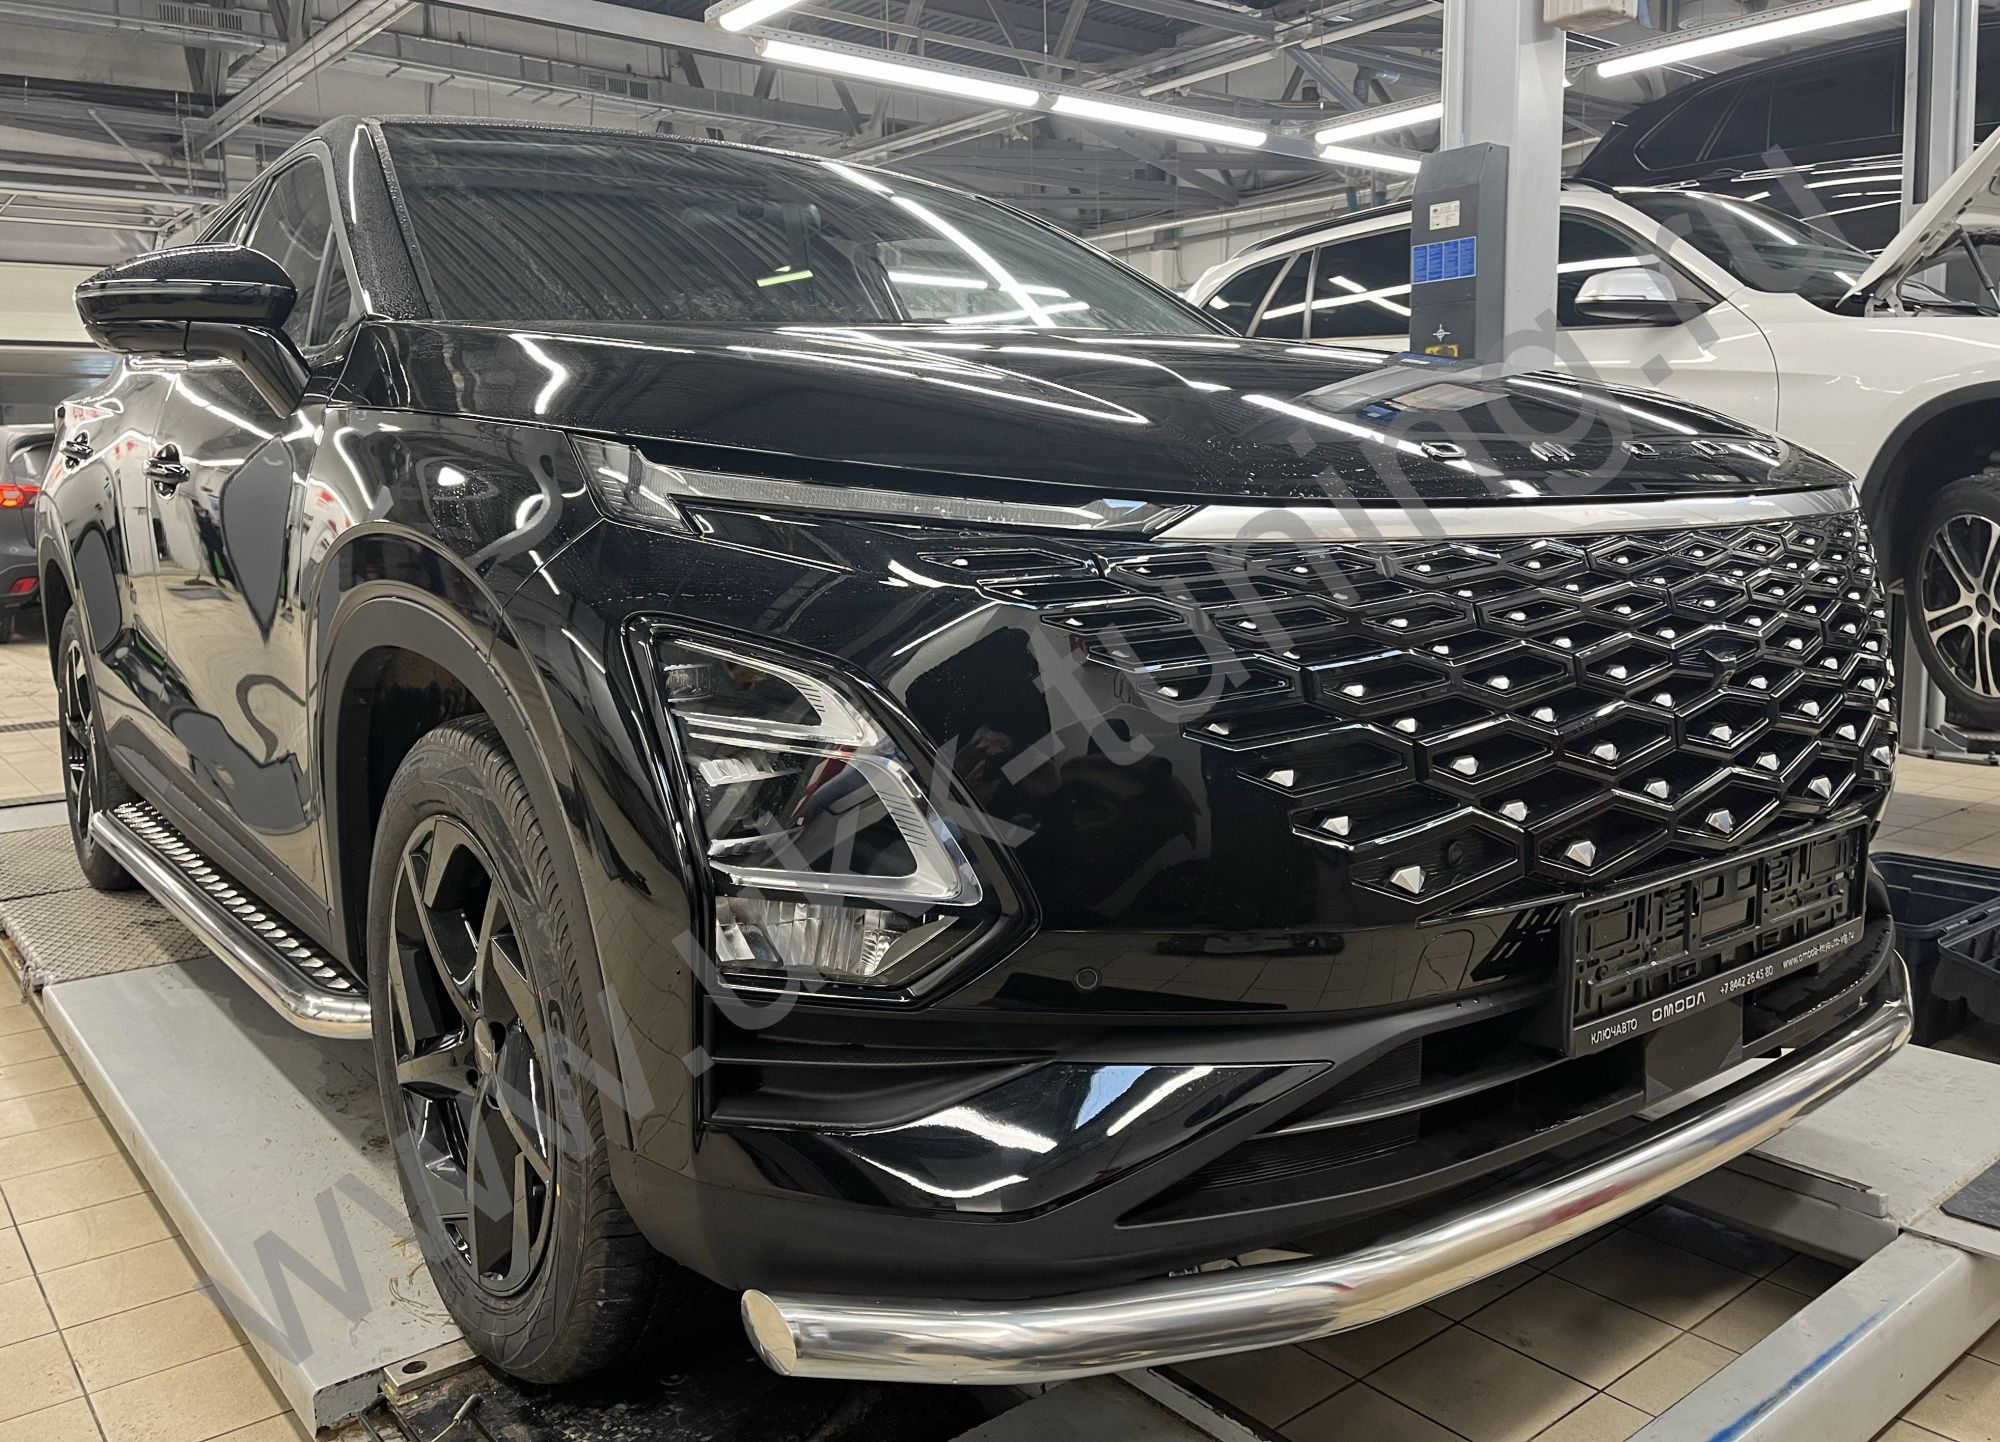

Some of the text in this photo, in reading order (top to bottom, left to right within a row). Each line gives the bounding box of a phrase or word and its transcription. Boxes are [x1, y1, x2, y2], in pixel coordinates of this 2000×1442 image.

[1590, 1018, 1638, 1045] КЛЮЧАВТО
[1651, 991, 1706, 1022] OMODA
[1719, 982, 1729, 994] +7
[1764, 965, 1774, 978] 80
